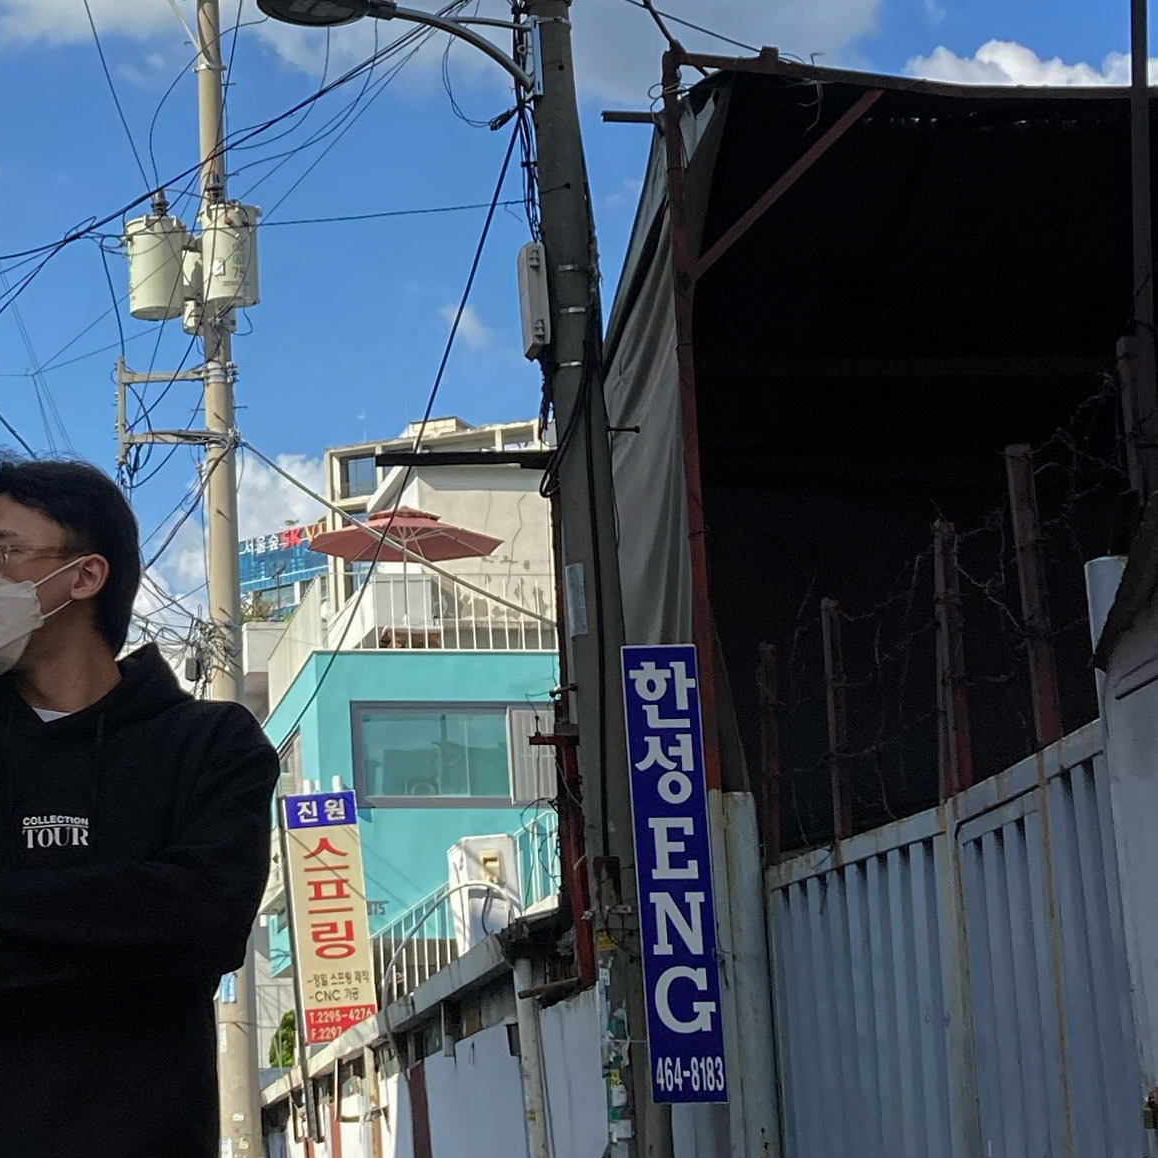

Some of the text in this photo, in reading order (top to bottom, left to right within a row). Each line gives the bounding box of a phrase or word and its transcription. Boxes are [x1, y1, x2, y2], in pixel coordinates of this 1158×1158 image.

[628, 661, 696, 804] 한성
[22, 815, 89, 826] COLLECTION
[297, 798, 346, 823] 진원
[22, 827, 89, 849] TOUR
[303, 837, 356, 959] 스프링
[648, 817, 717, 1034] ENG
[330, 971, 352, 985] 스프링
[309, 1007, 373, 1025] T.2295-4276
[656, 1055, 725, 1092] 464-8183
